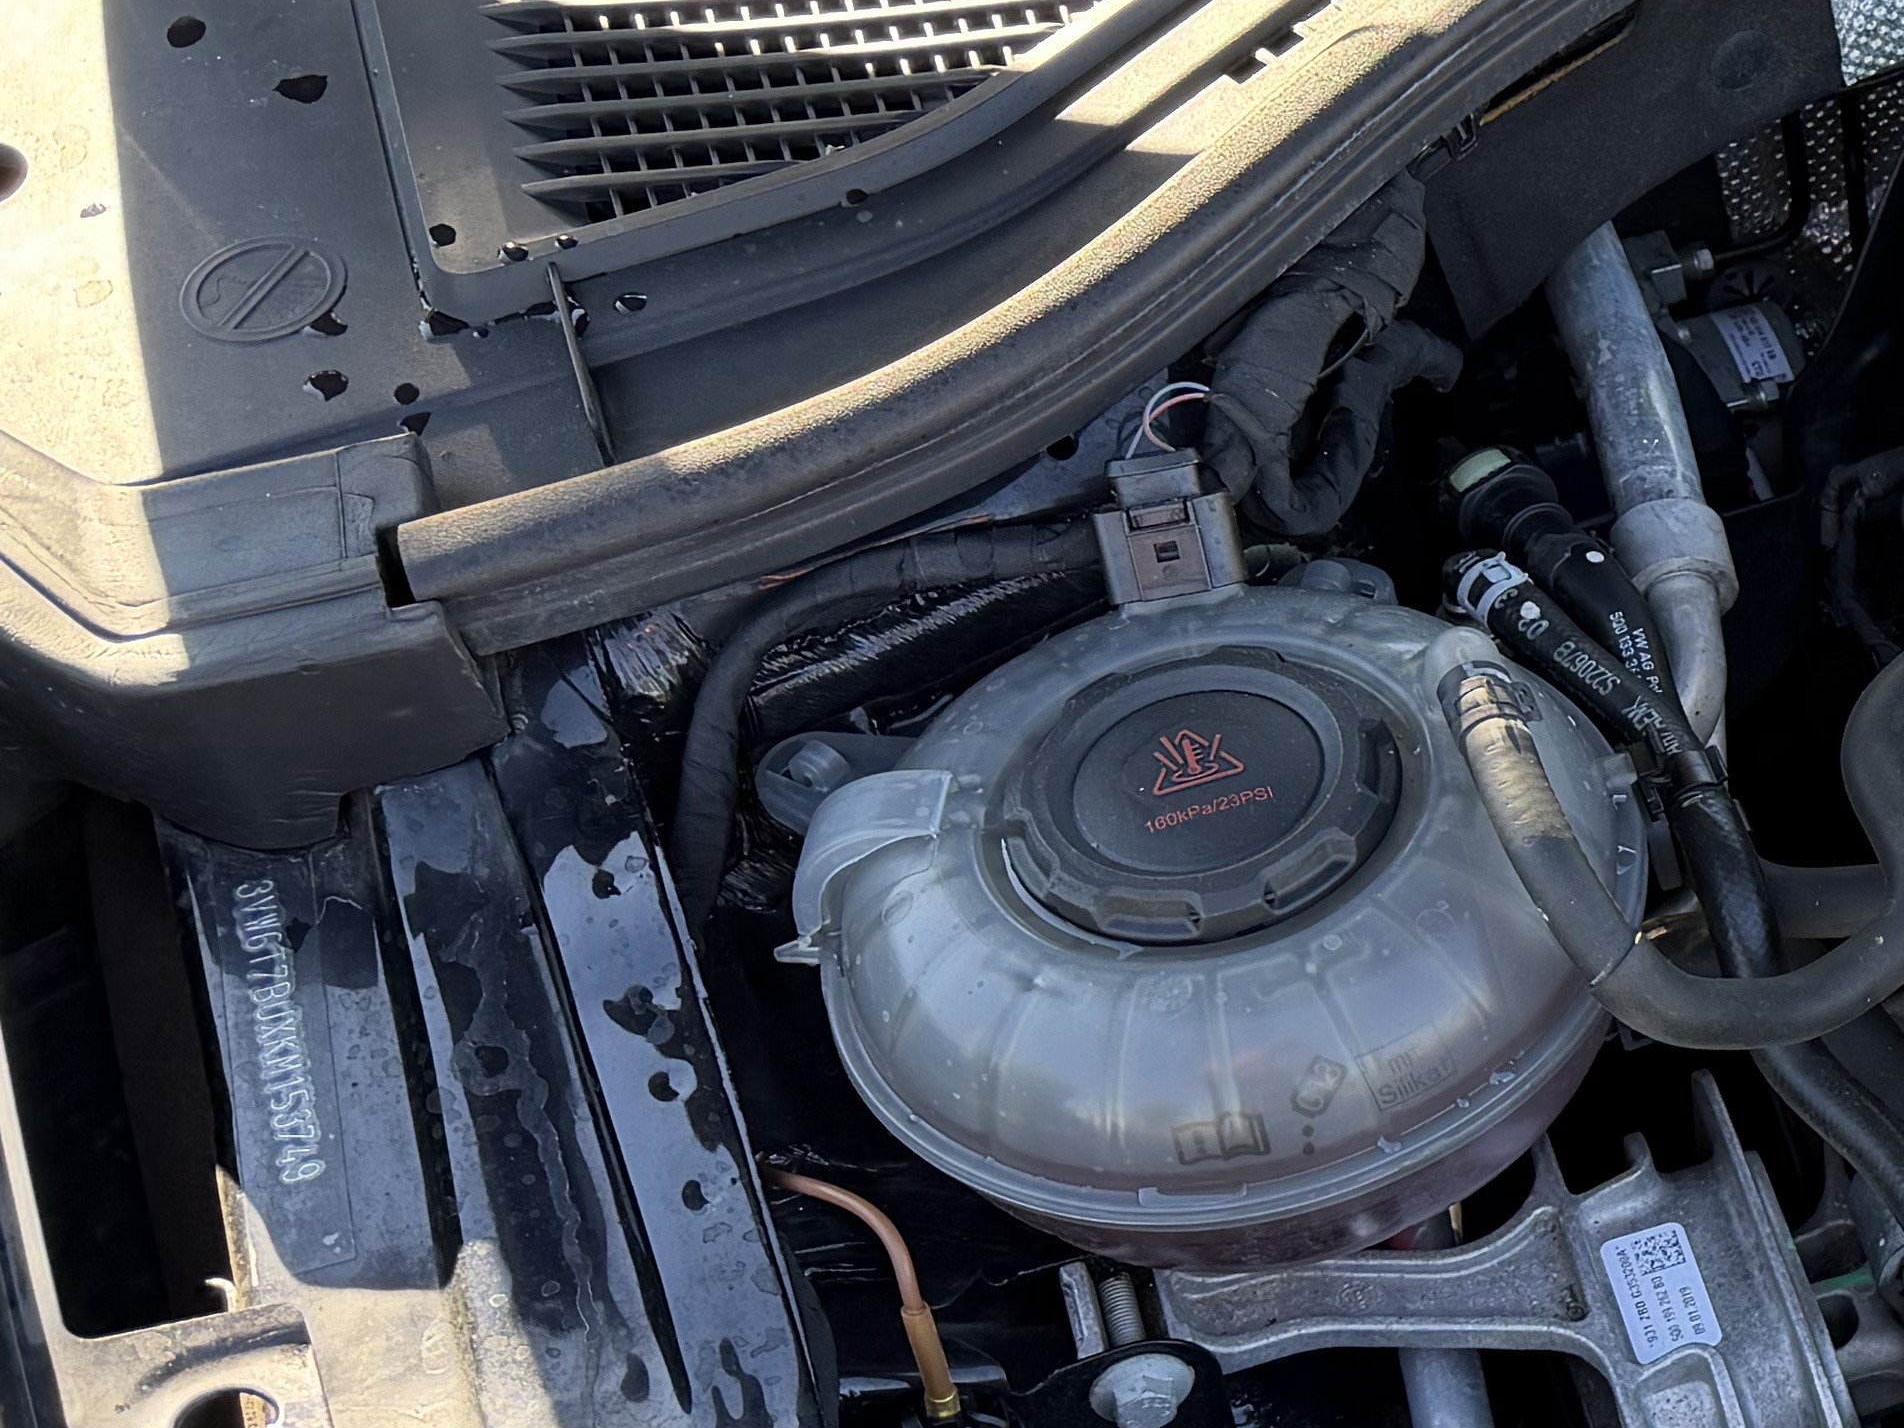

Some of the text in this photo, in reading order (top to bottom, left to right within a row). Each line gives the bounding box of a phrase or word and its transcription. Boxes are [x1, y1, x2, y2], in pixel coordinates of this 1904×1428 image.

[1553, 640, 1621, 695] S22067B
[1618, 635, 1634, 658] 133
[1632, 627, 1654, 671] VW AG
[1144, 785, 1275, 834] 160kPa/23PSI
